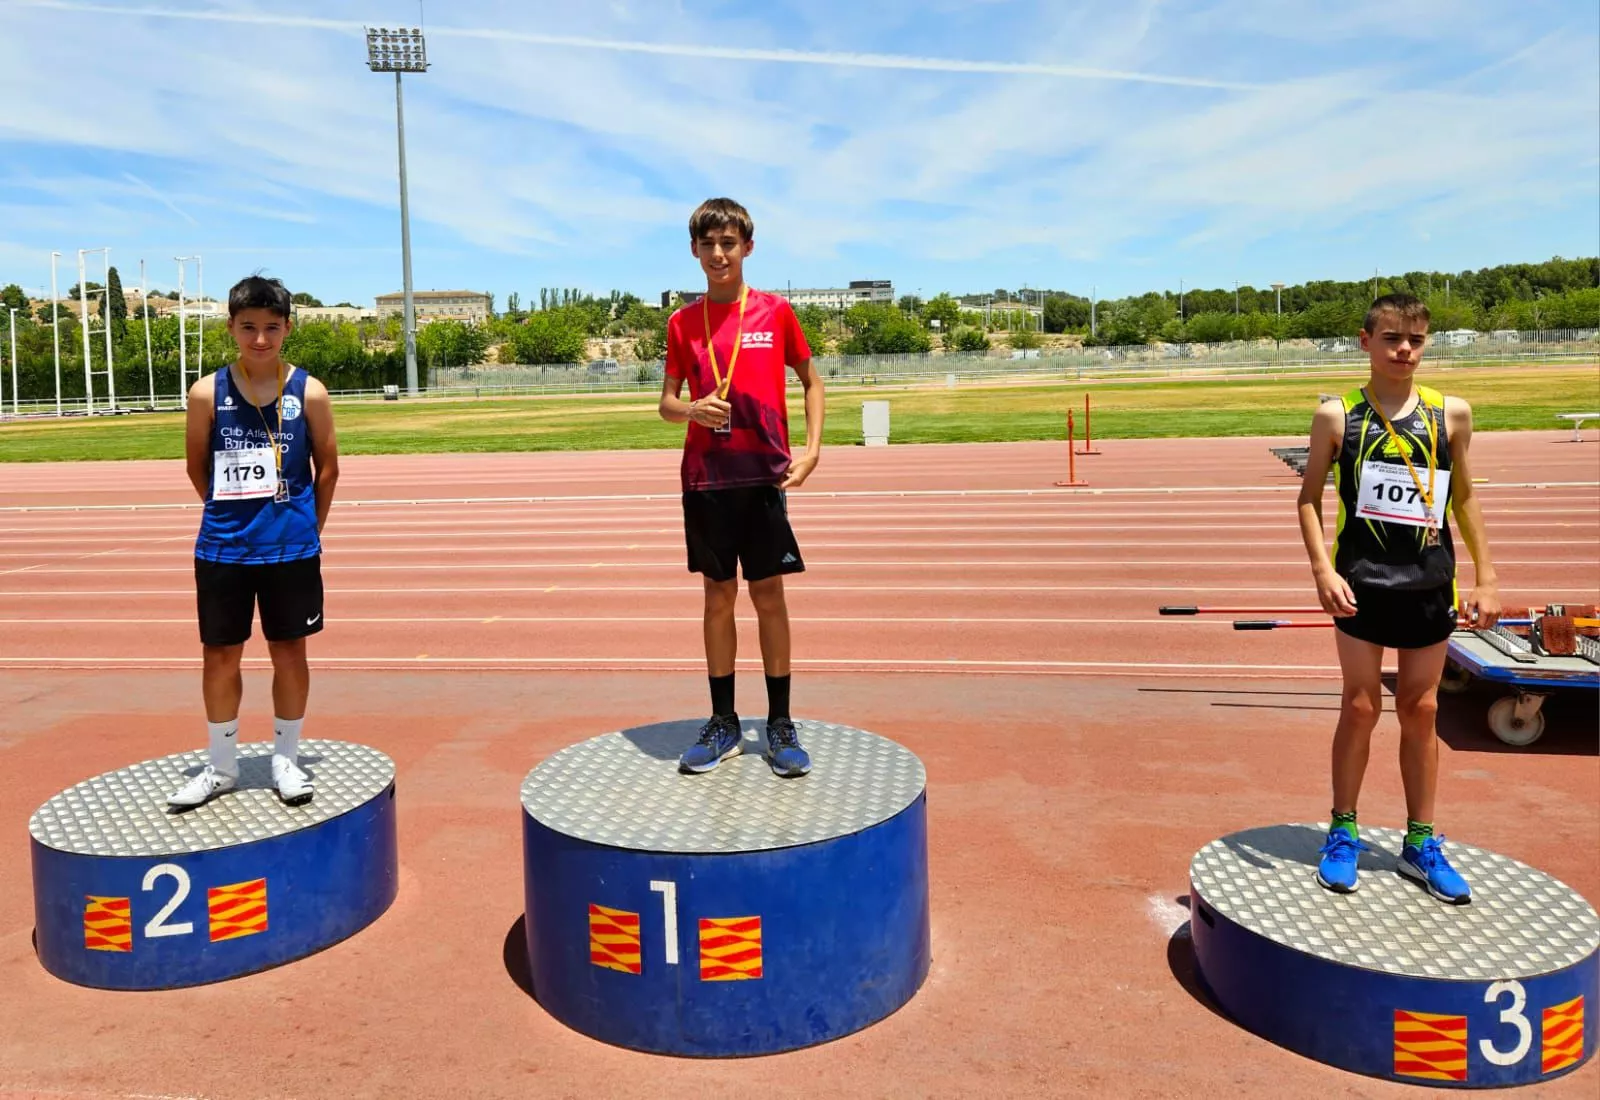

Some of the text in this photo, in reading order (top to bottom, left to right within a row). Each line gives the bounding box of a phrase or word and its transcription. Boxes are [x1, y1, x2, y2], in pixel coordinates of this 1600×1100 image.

[742, 331, 774, 342] ZGZ
[220, 426, 293, 440] Club Atlesmo
[224, 437, 289, 453] Barbasro
[223, 464, 265, 482] 1179
[141, 863, 193, 938] 2
[649, 880, 679, 965] 1
[1479, 979, 1532, 1066] 3
